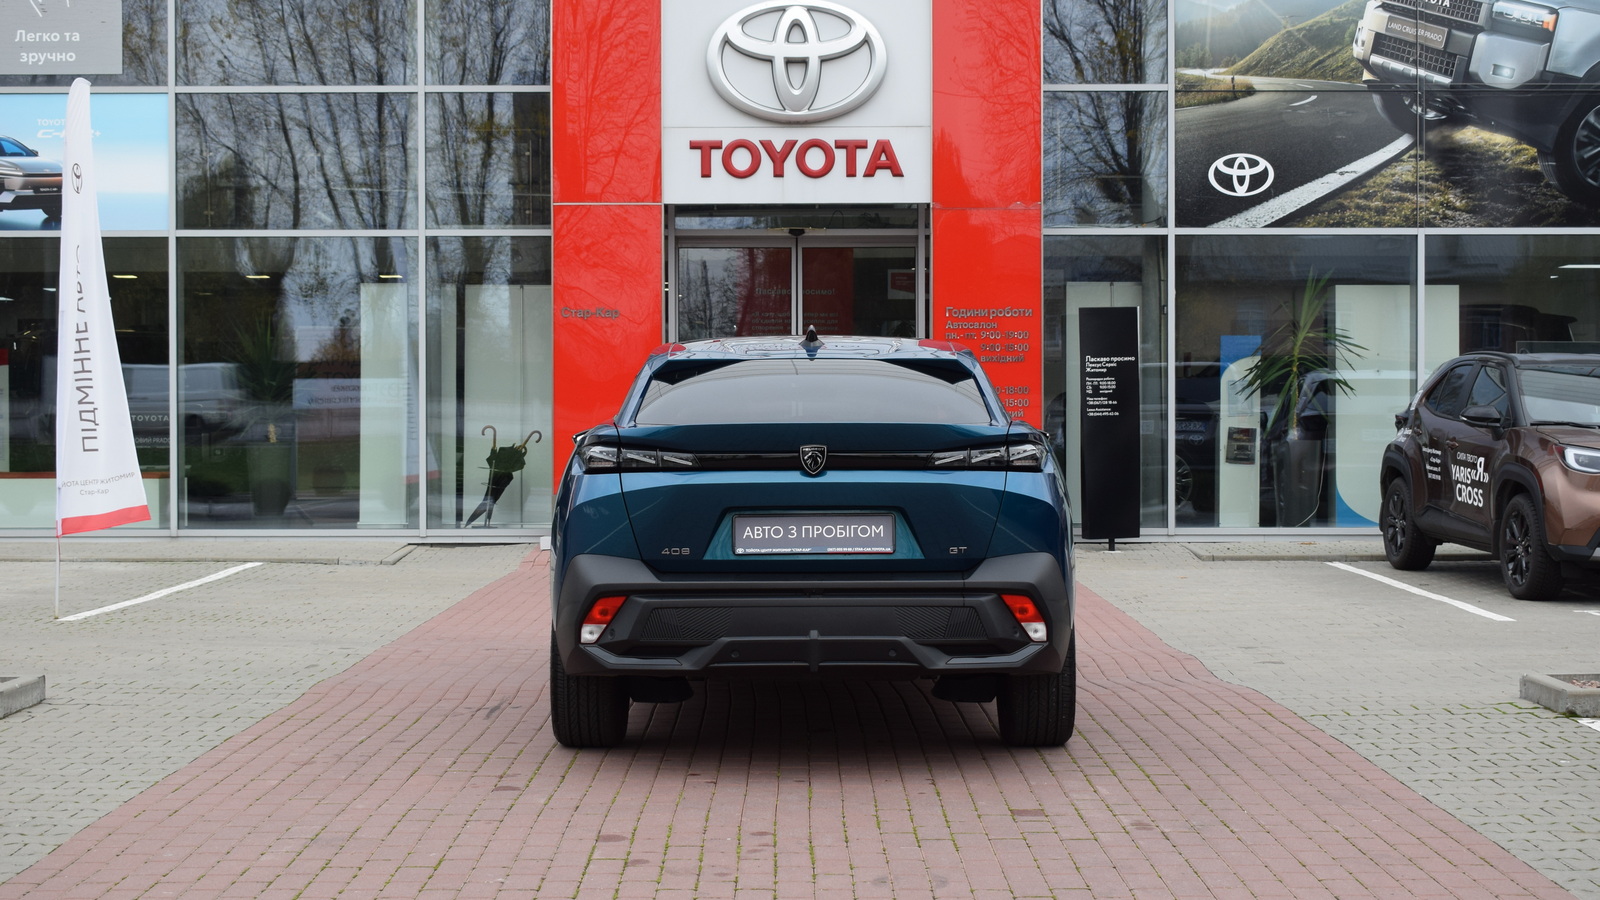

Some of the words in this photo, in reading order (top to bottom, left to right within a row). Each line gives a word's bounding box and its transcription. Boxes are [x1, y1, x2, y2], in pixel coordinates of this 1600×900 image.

[15, 30, 60, 42] Легко
[64, 32, 80, 41] та
[1388, 22, 1401, 30] LAND
[1402, 25, 1424, 36] CRUISER
[1425, 31, 1443, 41] PRADO
[20, 52, 76, 65] зручно
[689, 138, 905, 179] TOYOTA
[561, 306, 620, 320] Стар-Кар
[945, 307, 988, 319] Години
[990, 306, 1033, 319] роботи
[945, 320, 998, 329] Автосалон
[980, 331, 1029, 339] 9:00-19:00
[980, 343, 1029, 352] 9:00-15:00
[980, 354, 1025, 363] вихідний
[74, 321, 99, 453] ПІДМІННЕ
[996, 386, 1029, 394] 0-18:00
[1002, 398, 1029, 407] -15:00
[1451, 464, 1471, 484] YARIS
[61, 480, 79, 488] ЙОТА
[80, 488, 109, 496] Стар-Кар
[1456, 483, 1484, 507] CROSS
[743, 525, 784, 539] АВТО
[802, 525, 884, 538] ПРОБІГОМ
[661, 547, 690, 555] 408
[949, 546, 968, 554] GT
